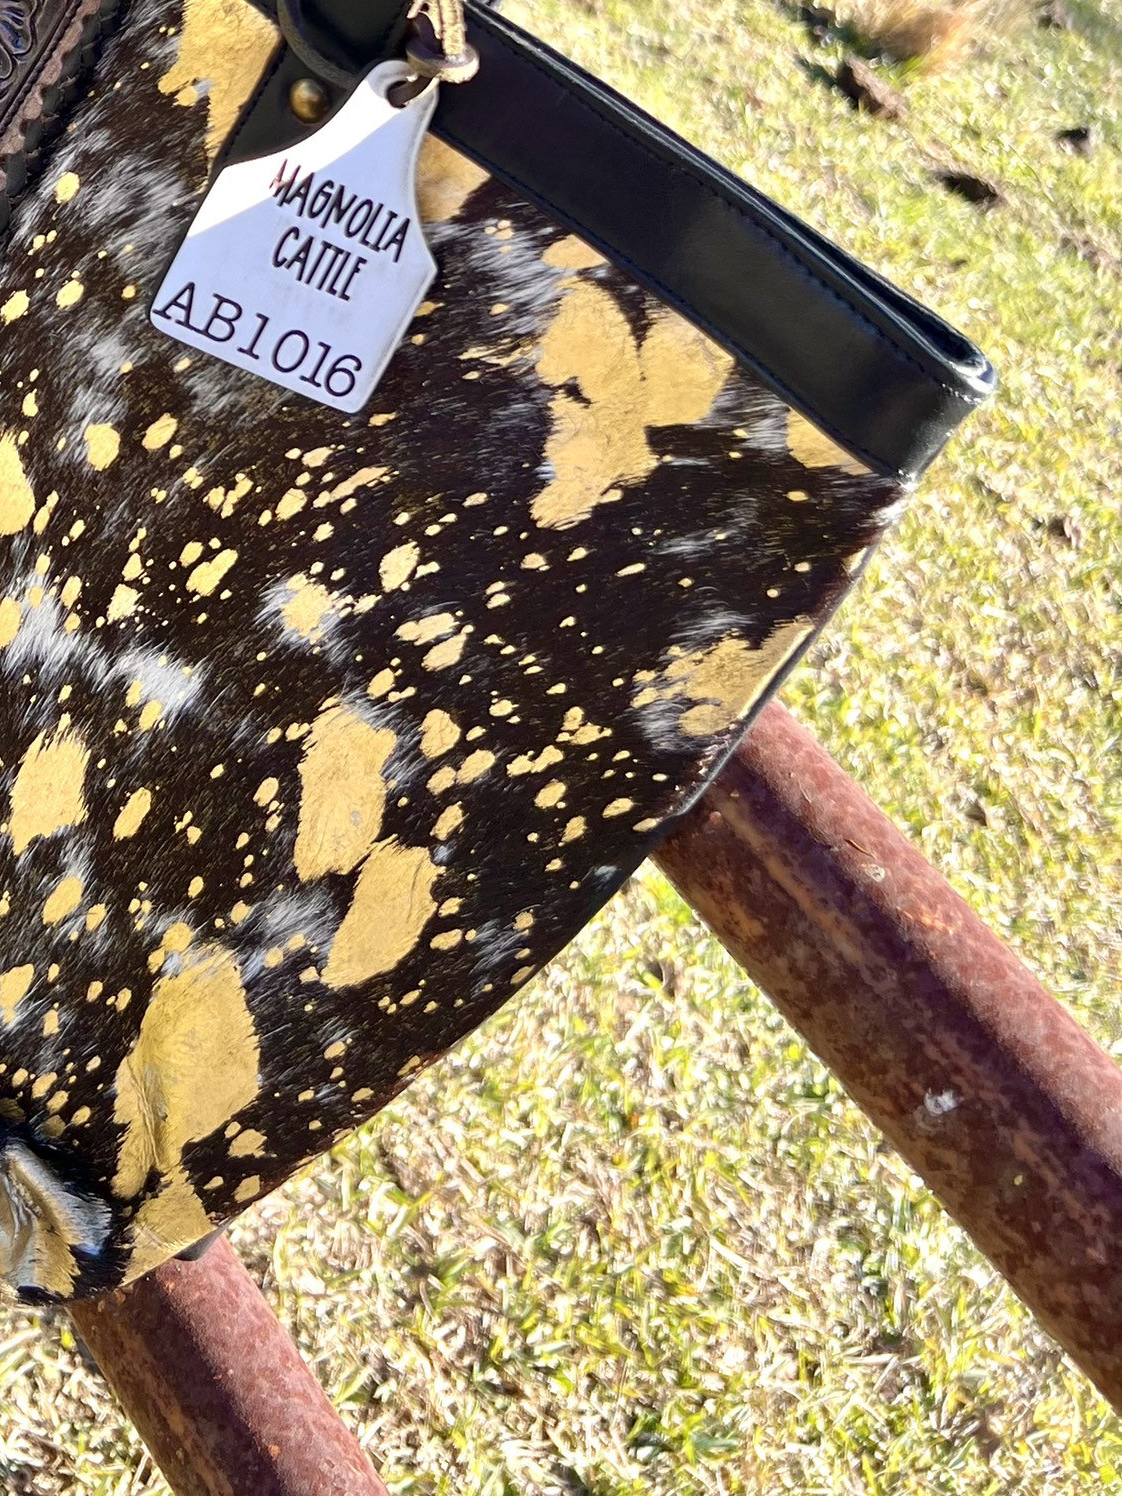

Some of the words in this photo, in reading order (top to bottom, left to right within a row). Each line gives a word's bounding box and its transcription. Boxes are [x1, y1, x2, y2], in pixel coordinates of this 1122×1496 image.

[269, 159, 411, 262] MAGNOLIA
[272, 226, 367, 301] CATTLE
[152, 282, 363, 397] AB1016
